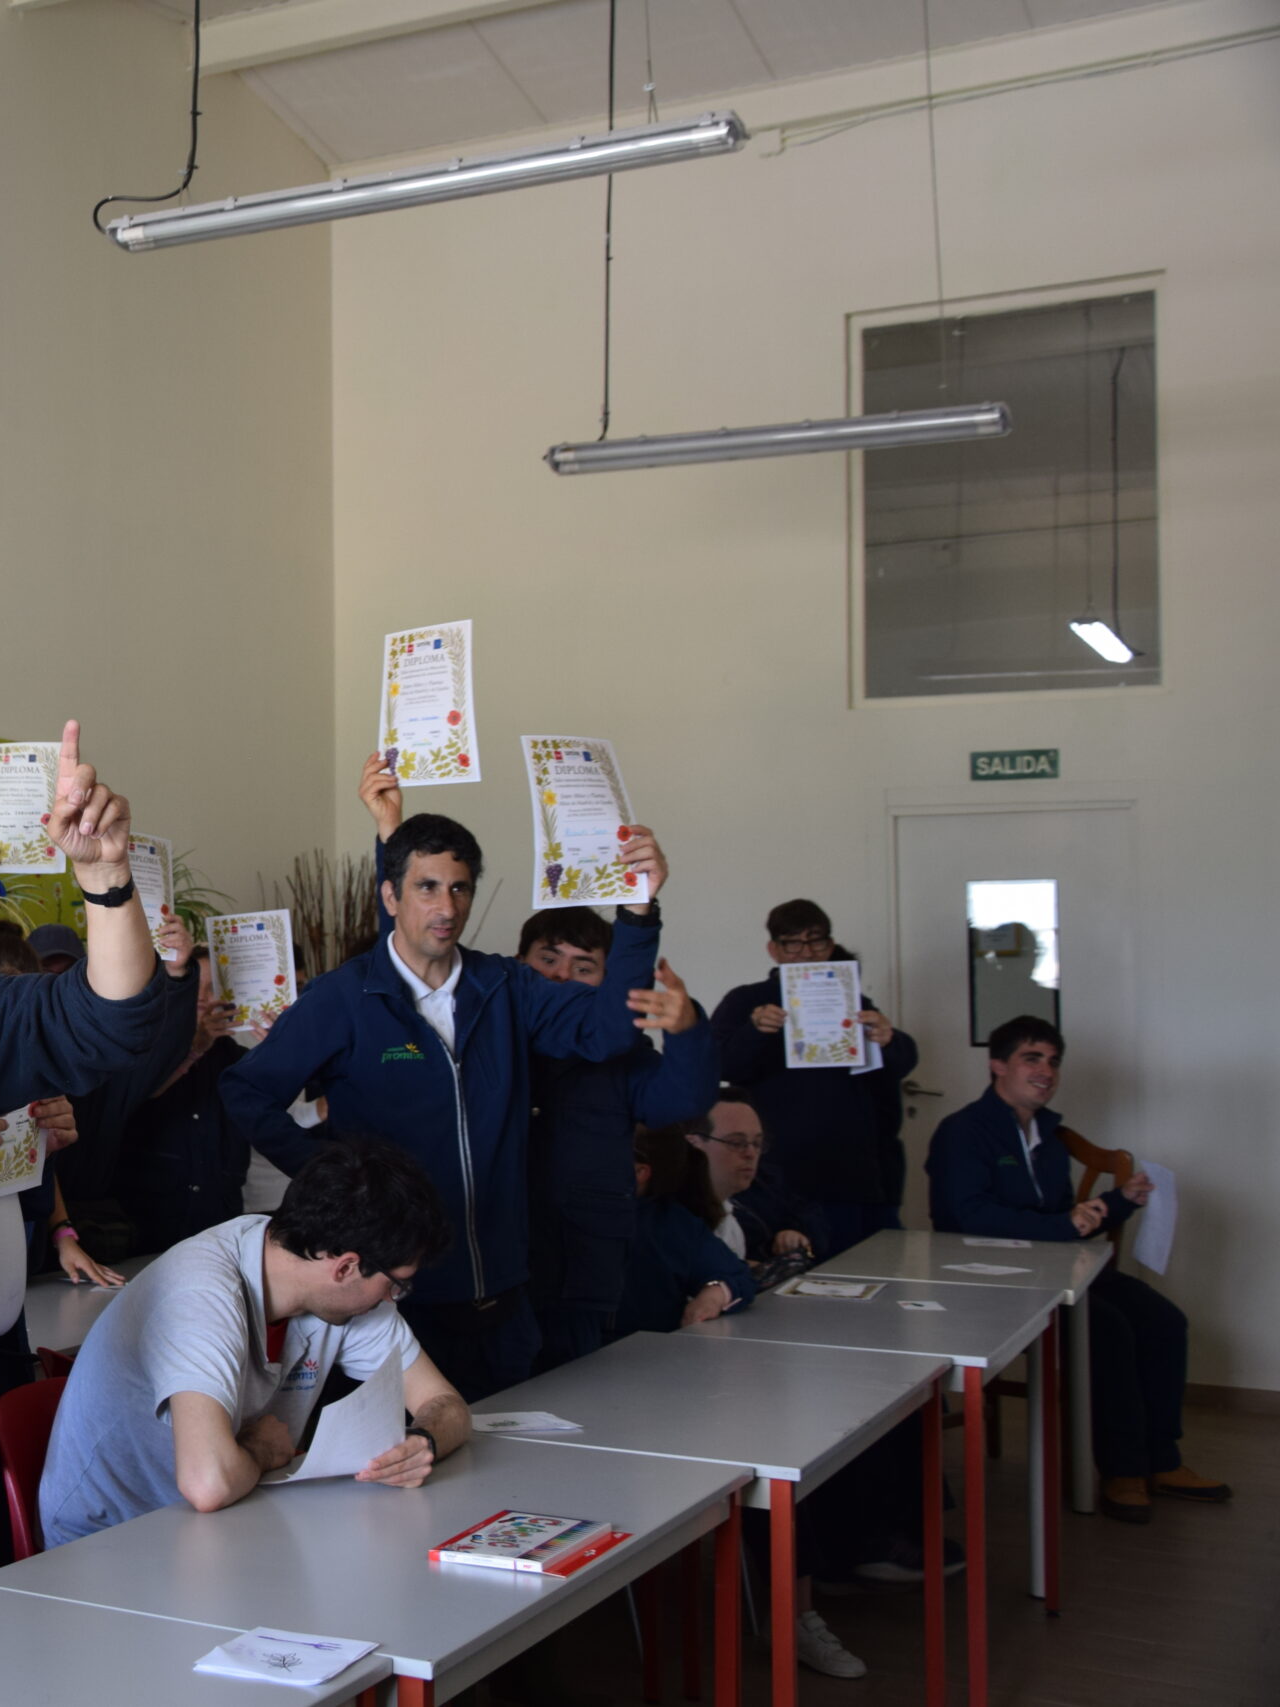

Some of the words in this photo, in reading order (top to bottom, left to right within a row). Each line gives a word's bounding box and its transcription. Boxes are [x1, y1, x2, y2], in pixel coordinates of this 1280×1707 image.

[0, 766, 40, 774] DIPLOMA
[554, 765, 601, 776] DIPLOMA
[976, 755, 1053, 776] SALIDA
[230, 933, 270, 944] DIPLOMA
